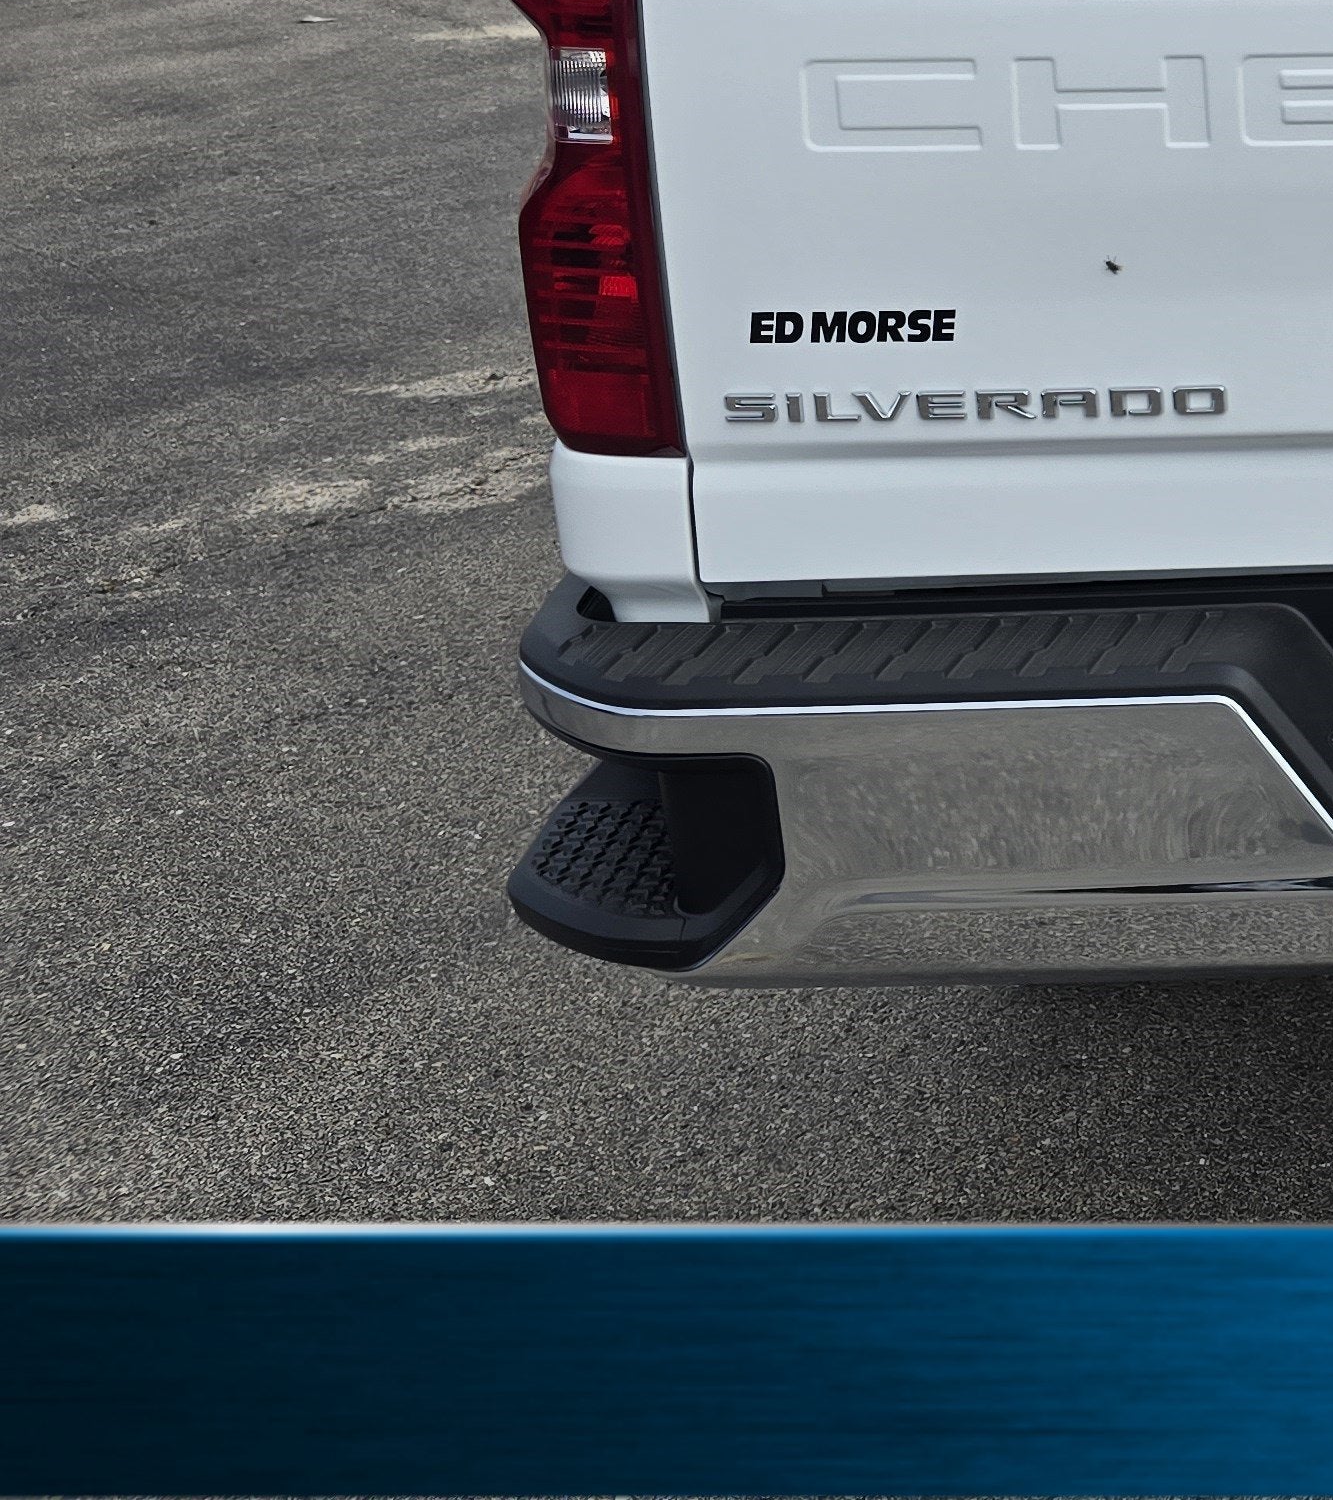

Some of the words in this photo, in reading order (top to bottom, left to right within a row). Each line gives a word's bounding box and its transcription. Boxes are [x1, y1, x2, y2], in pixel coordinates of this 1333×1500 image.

[749, 311, 803, 344] ED
[810, 309, 957, 344] MORSE
[723, 384, 1227, 423] SILVERADO
